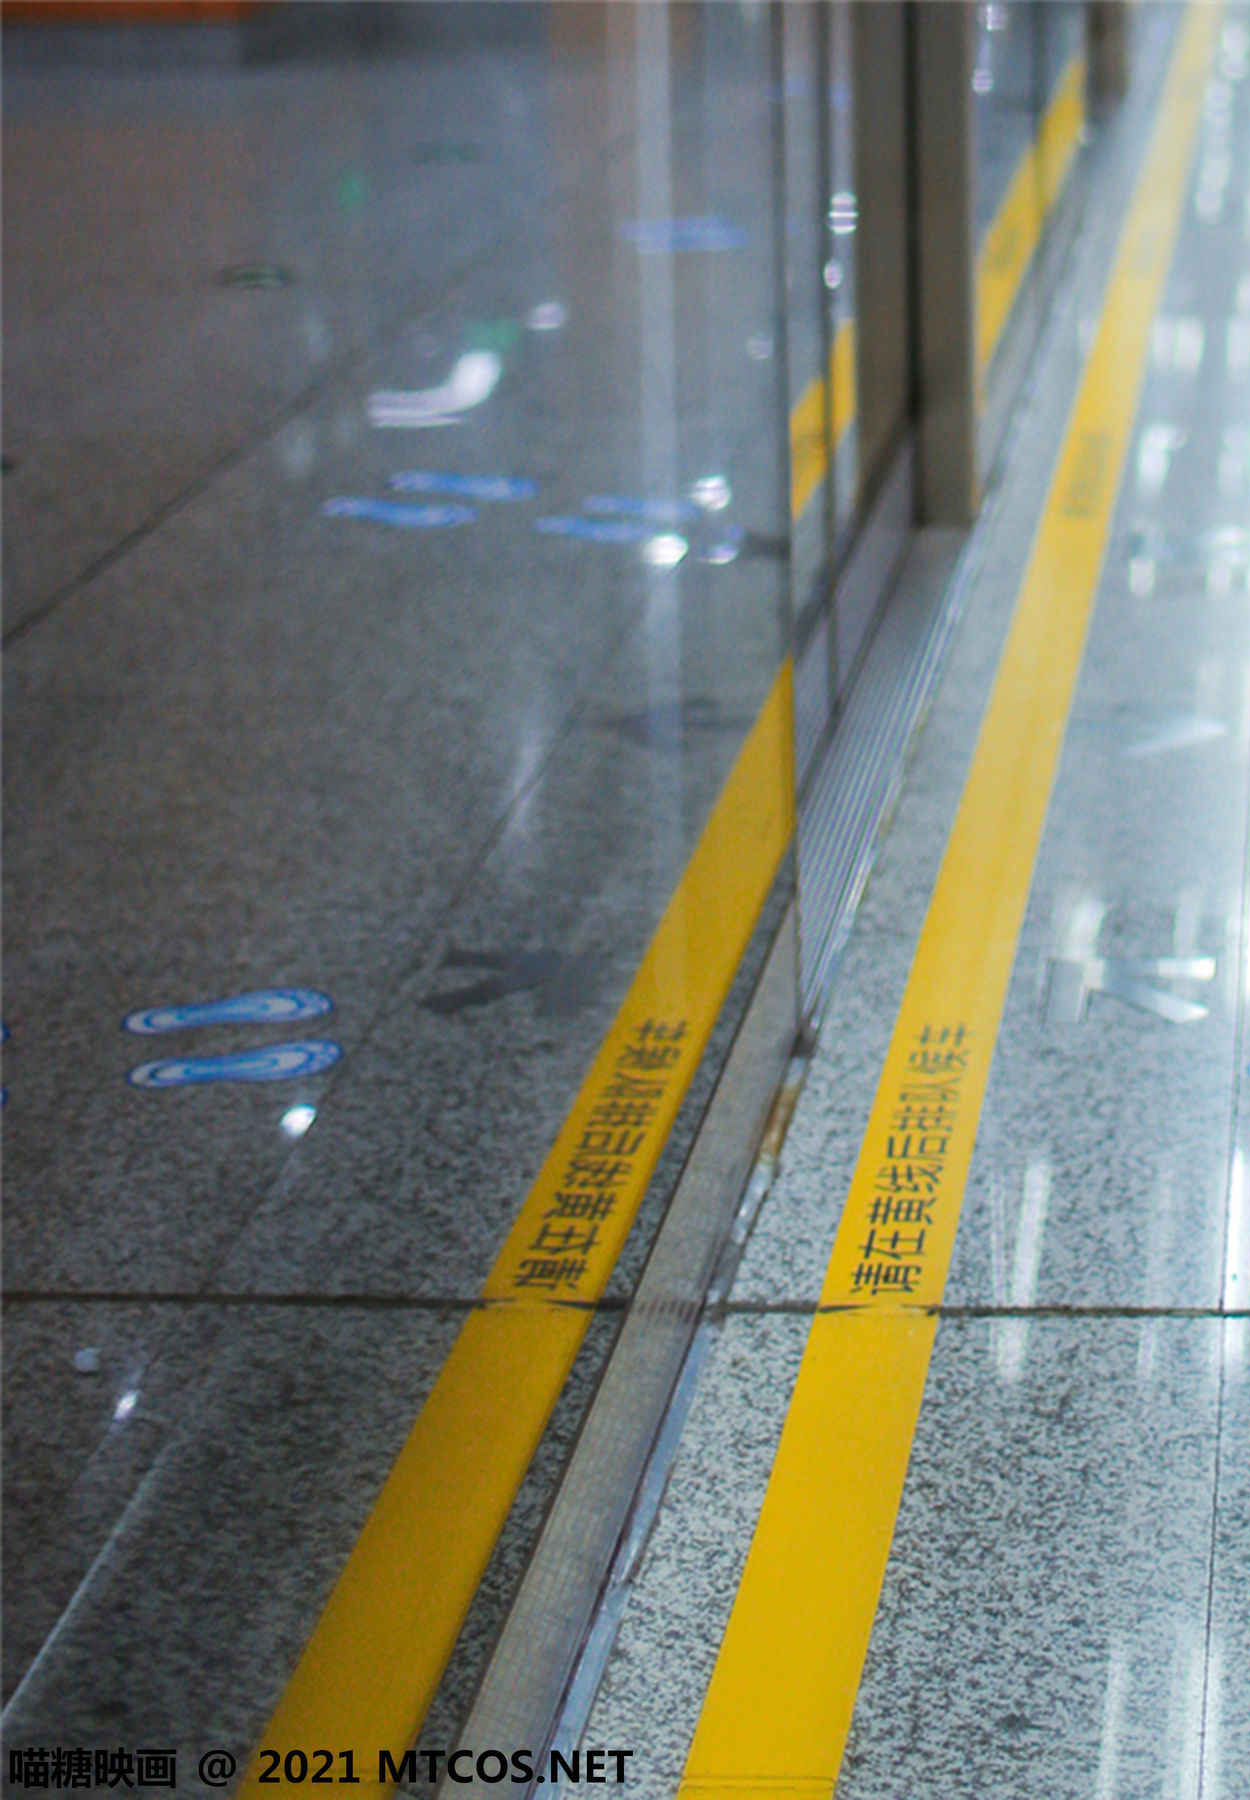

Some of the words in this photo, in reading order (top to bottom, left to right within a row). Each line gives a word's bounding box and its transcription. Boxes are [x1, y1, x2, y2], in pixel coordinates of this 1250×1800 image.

[848, 1020, 973, 1296] 请在黄线后排队候车
